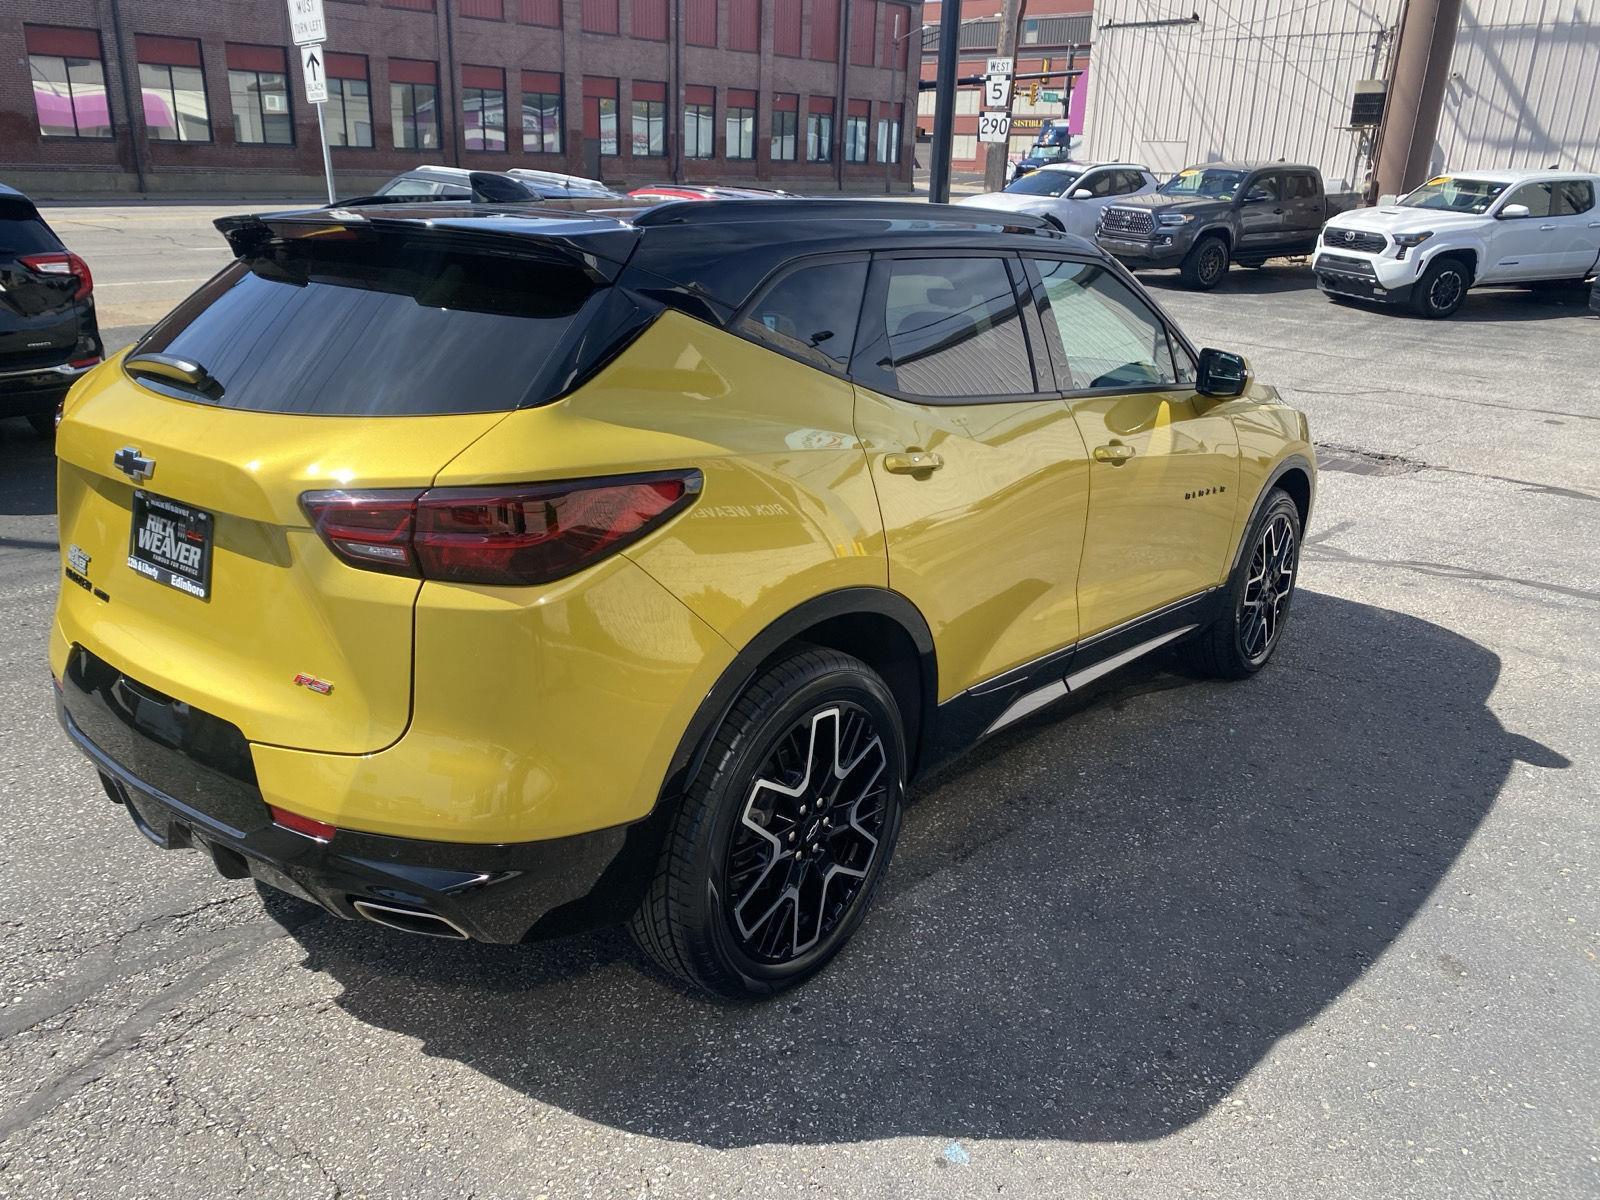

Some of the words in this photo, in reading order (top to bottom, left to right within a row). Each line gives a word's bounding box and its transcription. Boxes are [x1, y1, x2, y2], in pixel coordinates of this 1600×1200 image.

[293, 22, 309, 34] TURN
[309, 19, 322, 33] LEFT
[990, 61, 1010, 72] WEST
[992, 83, 1003, 100] 5
[980, 118, 1008, 135] 290
[145, 514, 177, 542] RICK
[138, 527, 202, 569] WEAVER
[142, 563, 159, 580] Liberty
[152, 553, 170, 567] FAMOUS
[170, 559, 180, 570] FOR
[179, 563, 199, 577] SERVICE
[170, 574, 205, 598] Edinboro
[294, 674, 331, 694] RS
